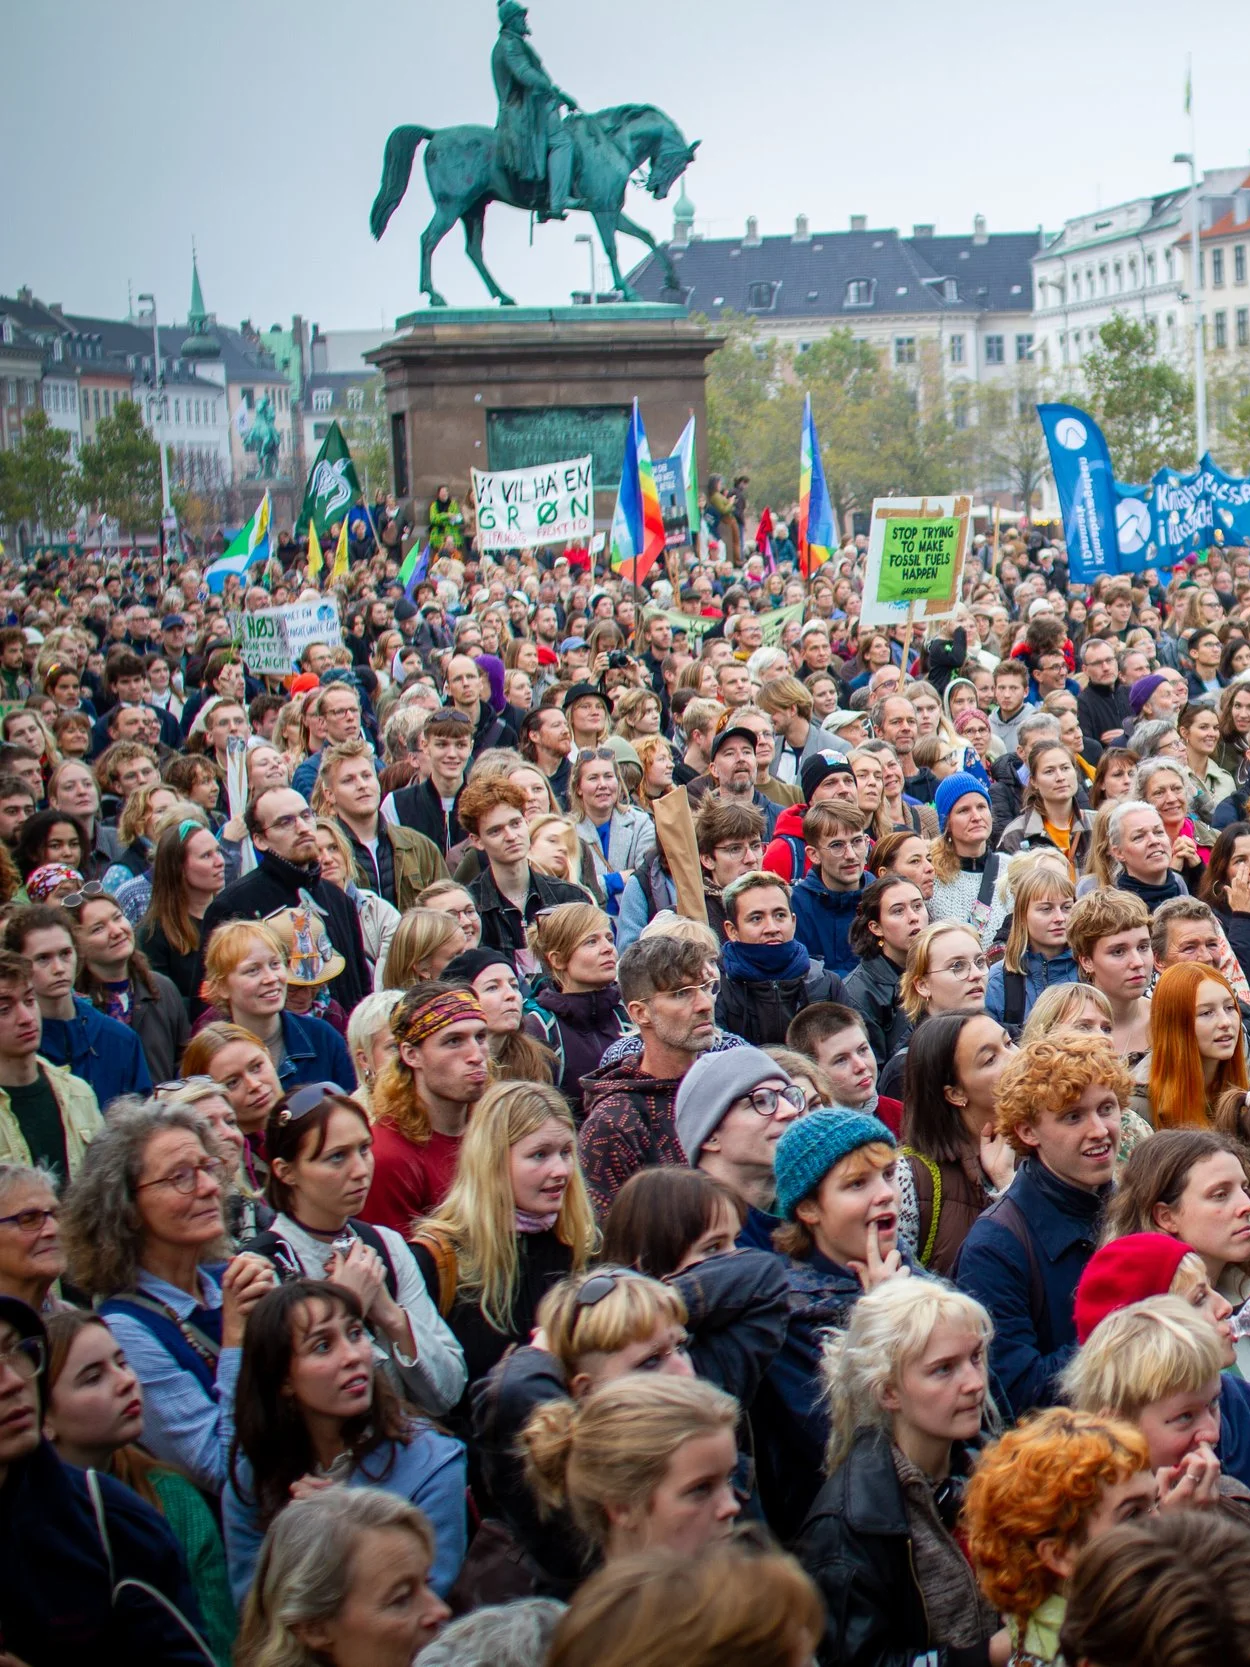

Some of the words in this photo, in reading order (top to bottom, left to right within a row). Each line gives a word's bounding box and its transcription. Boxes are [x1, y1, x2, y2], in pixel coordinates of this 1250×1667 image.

[501, 479, 530, 503] VIL
[564, 464, 591, 492] EN
[892, 527, 918, 540] STOP
[922, 525, 954, 540] TRYING
[901, 541, 915, 553] TO
[918, 540, 944, 553] MAKE
[889, 554, 921, 568] FOSSIL
[925, 552, 951, 566] FUELS
[902, 567, 938, 580] HAPPEN
[246, 615, 276, 639] HØJ
